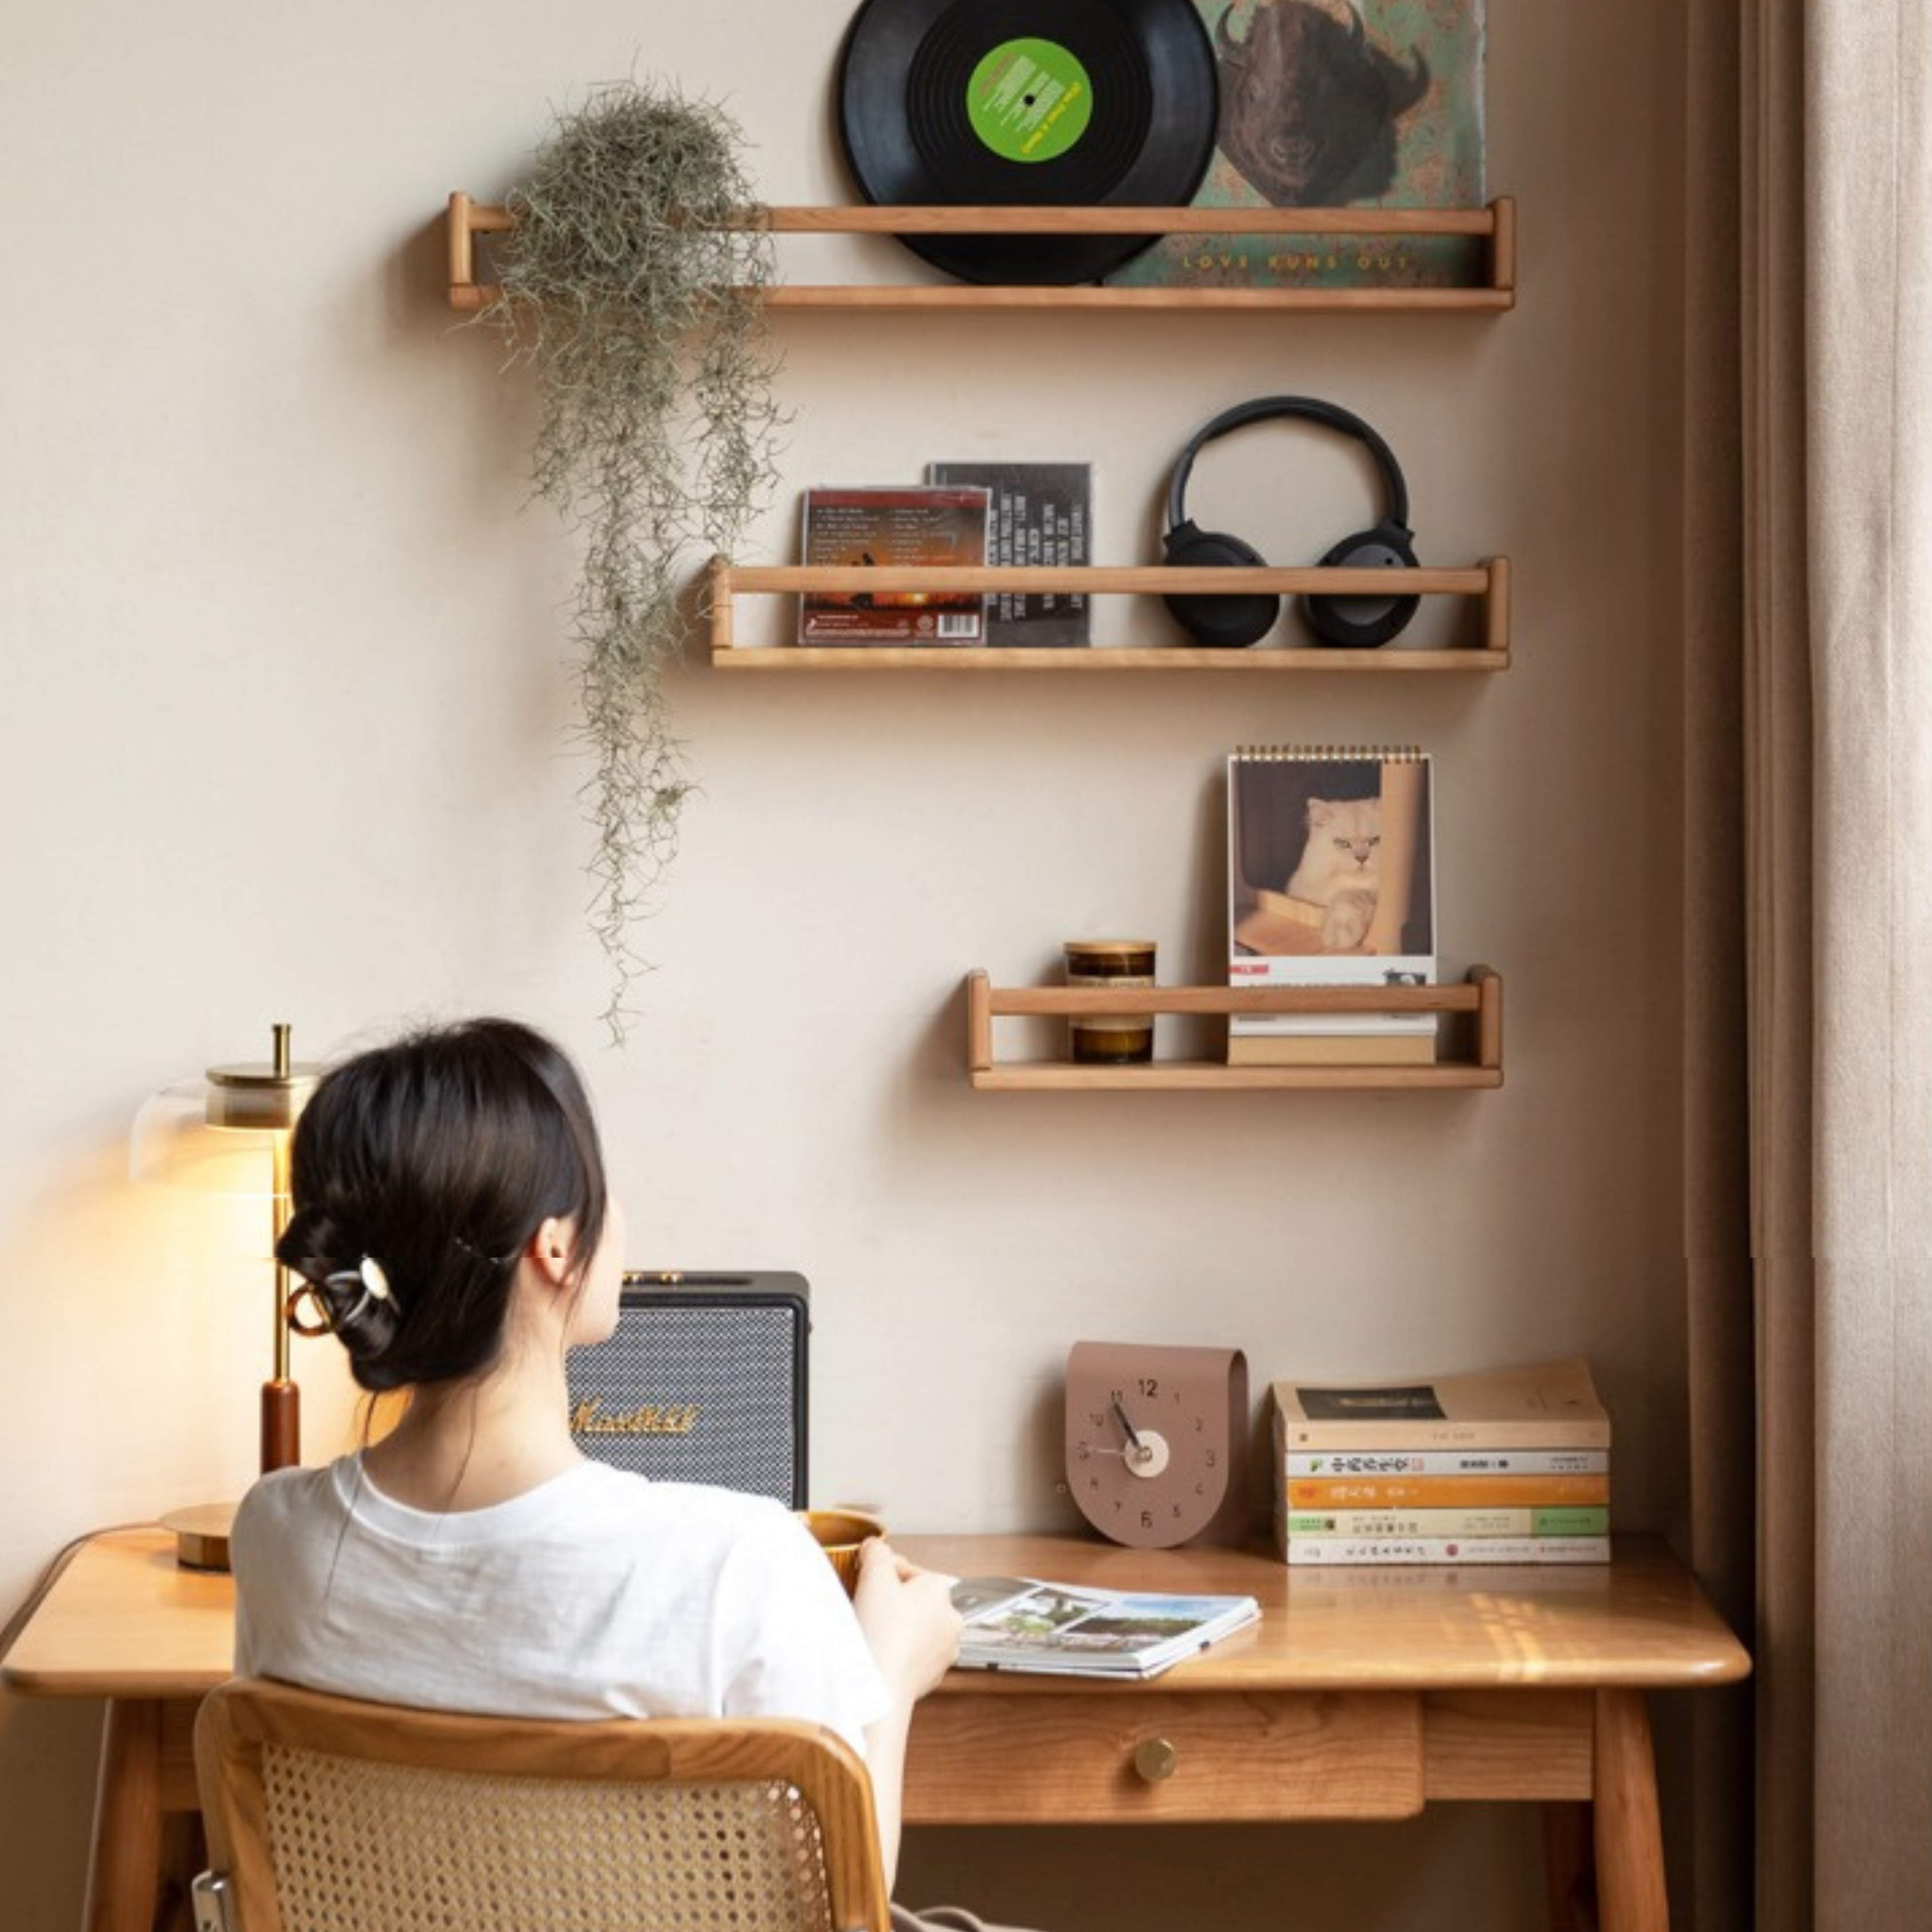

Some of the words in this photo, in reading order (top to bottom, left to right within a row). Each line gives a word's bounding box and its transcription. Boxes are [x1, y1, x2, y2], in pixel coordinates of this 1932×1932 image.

[1183, 255, 1248, 268] LOVE
[1269, 255, 1336, 269] RUNS
[1357, 255, 1407, 269] OUT
[1137, 1378, 1159, 1398] 12
[1089, 1412, 1104, 1427] 10
[1206, 1449, 1215, 1467] 3
[1140, 1510, 1153, 1529] 6
